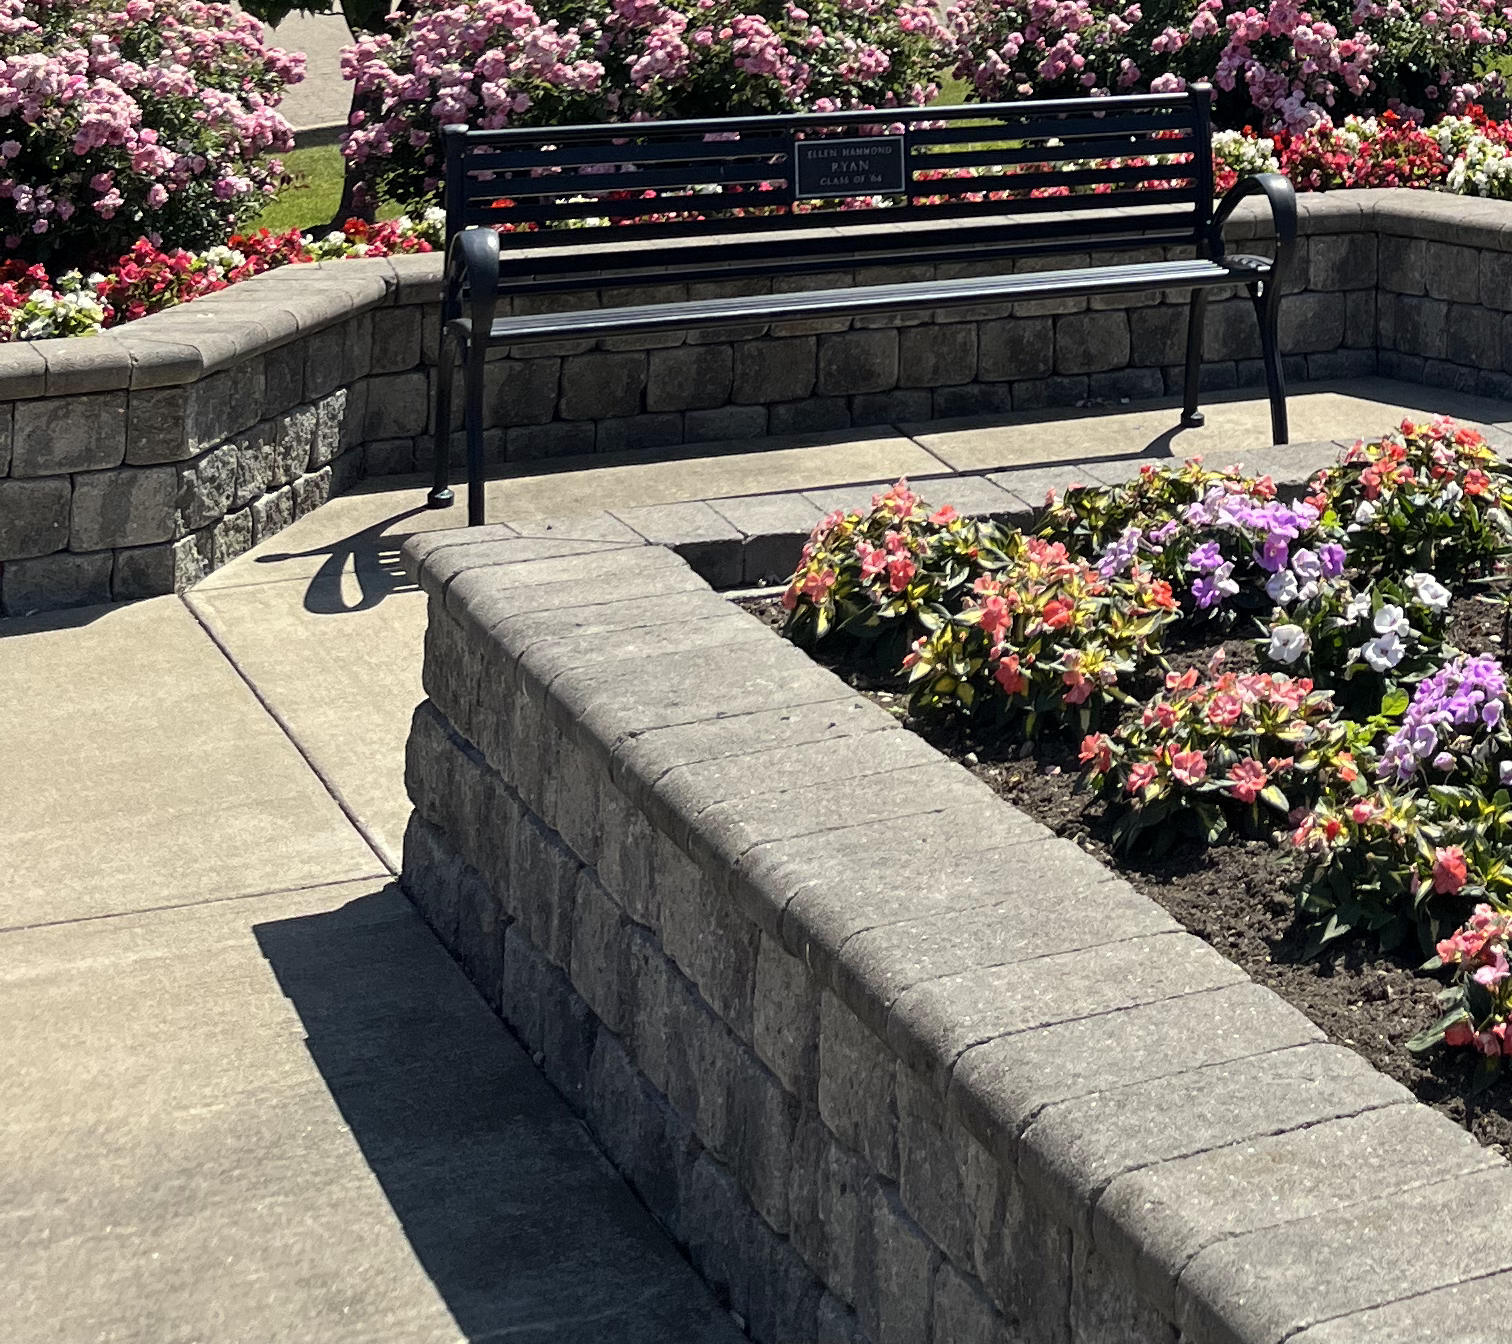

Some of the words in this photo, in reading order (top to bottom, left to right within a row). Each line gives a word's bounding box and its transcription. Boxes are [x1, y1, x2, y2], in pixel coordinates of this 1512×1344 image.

[807, 149, 837, 159] ELLEN
[842, 145, 892, 157] HAMMOND
[831, 160, 869, 172] RYAN
[819, 175, 849, 186] CLASS
[853, 174, 866, 184] OF
